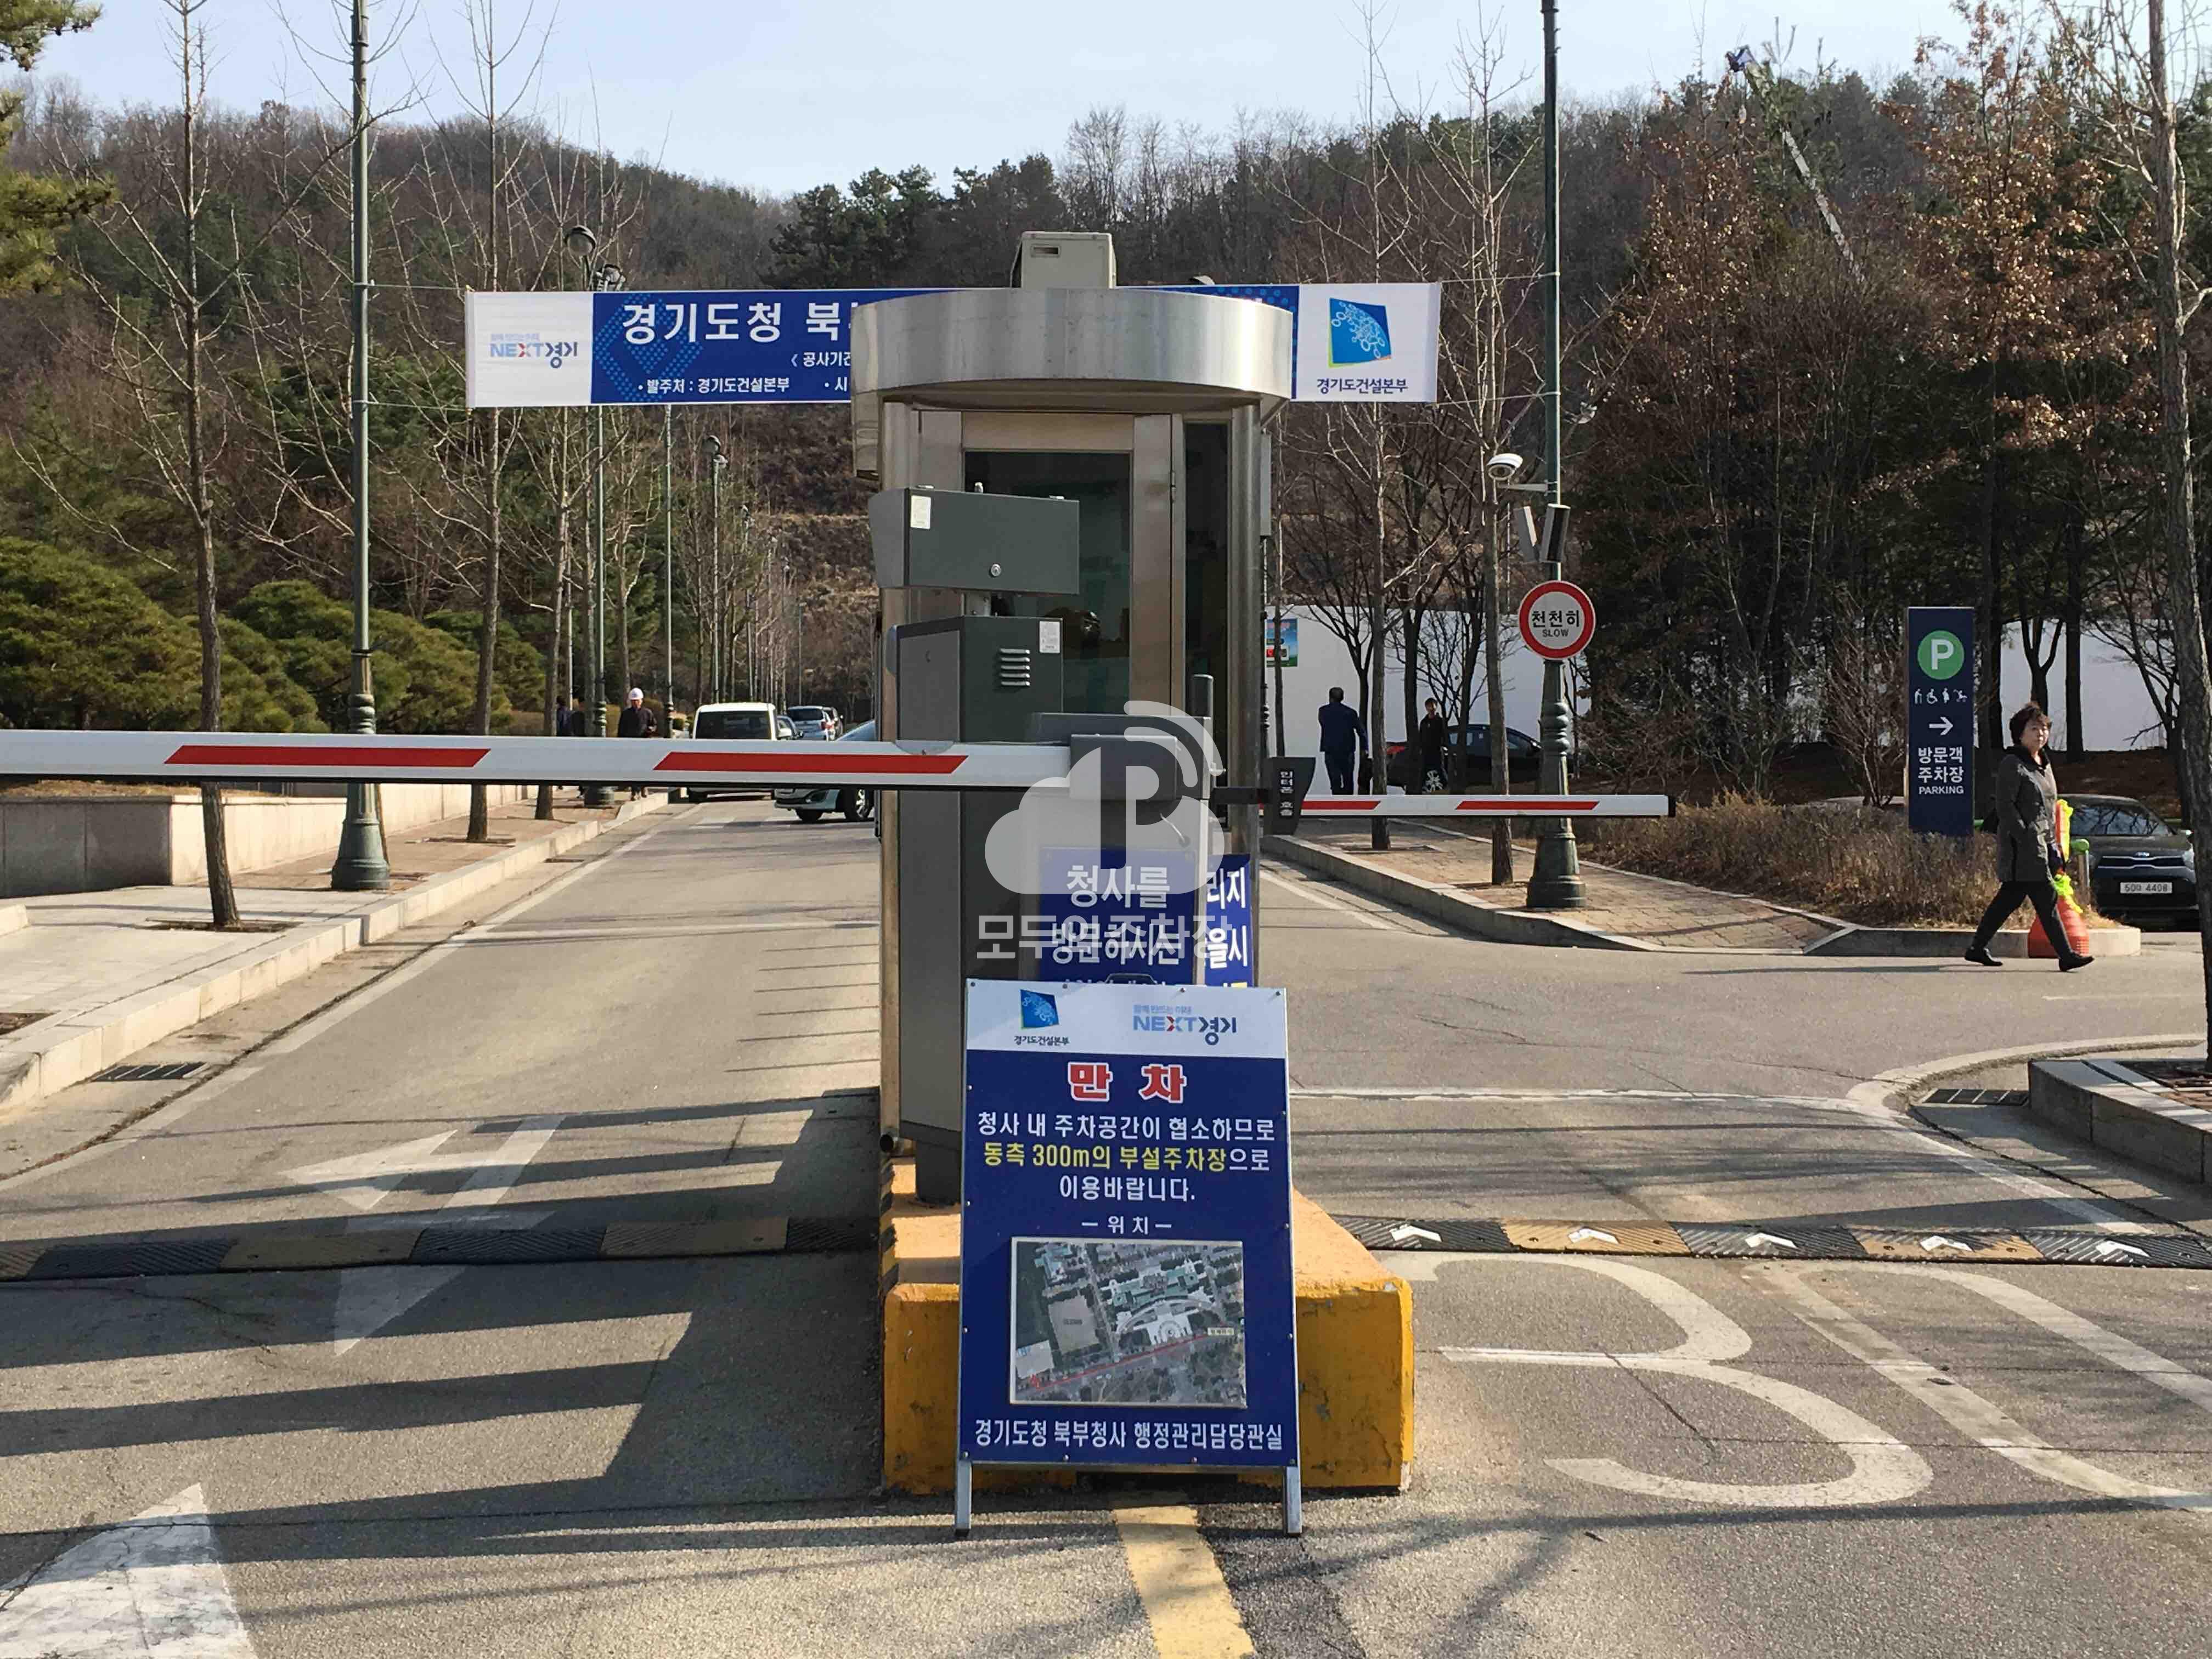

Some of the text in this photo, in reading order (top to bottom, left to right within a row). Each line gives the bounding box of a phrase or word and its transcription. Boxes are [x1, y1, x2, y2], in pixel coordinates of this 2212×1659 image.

[623, 302, 858, 344] 경기도청 북
[647, 379, 685, 394] 발주처
[697, 377, 789, 394] 경기도건설본부
[1317, 378, 1408, 394] 경기도건설본부
[1531, 610, 1579, 628] 천천히
[1542, 629, 1569, 637] SLOW
[1932, 639, 1955, 670] P
[1918, 747, 1962, 764] 방문객
[1918, 766, 1964, 783] 주차장
[1918, 786, 1964, 794] PARKING
[1066, 865, 1170, 909] 청사를
[1051, 922, 1182, 966] 방문하시는
[1204, 925, 1248, 969] 을시
[978, 1111, 1276, 1142] 청사 내 주차공간이 협소하므로
[984, 1142, 1270, 1172] 동측 300m의 부설주차장으로
[1059, 1175, 1195, 1202] 이용바랍니다.
[975, 1419, 1283, 1451] 경기도청 북부청사 행정관리담당관실
